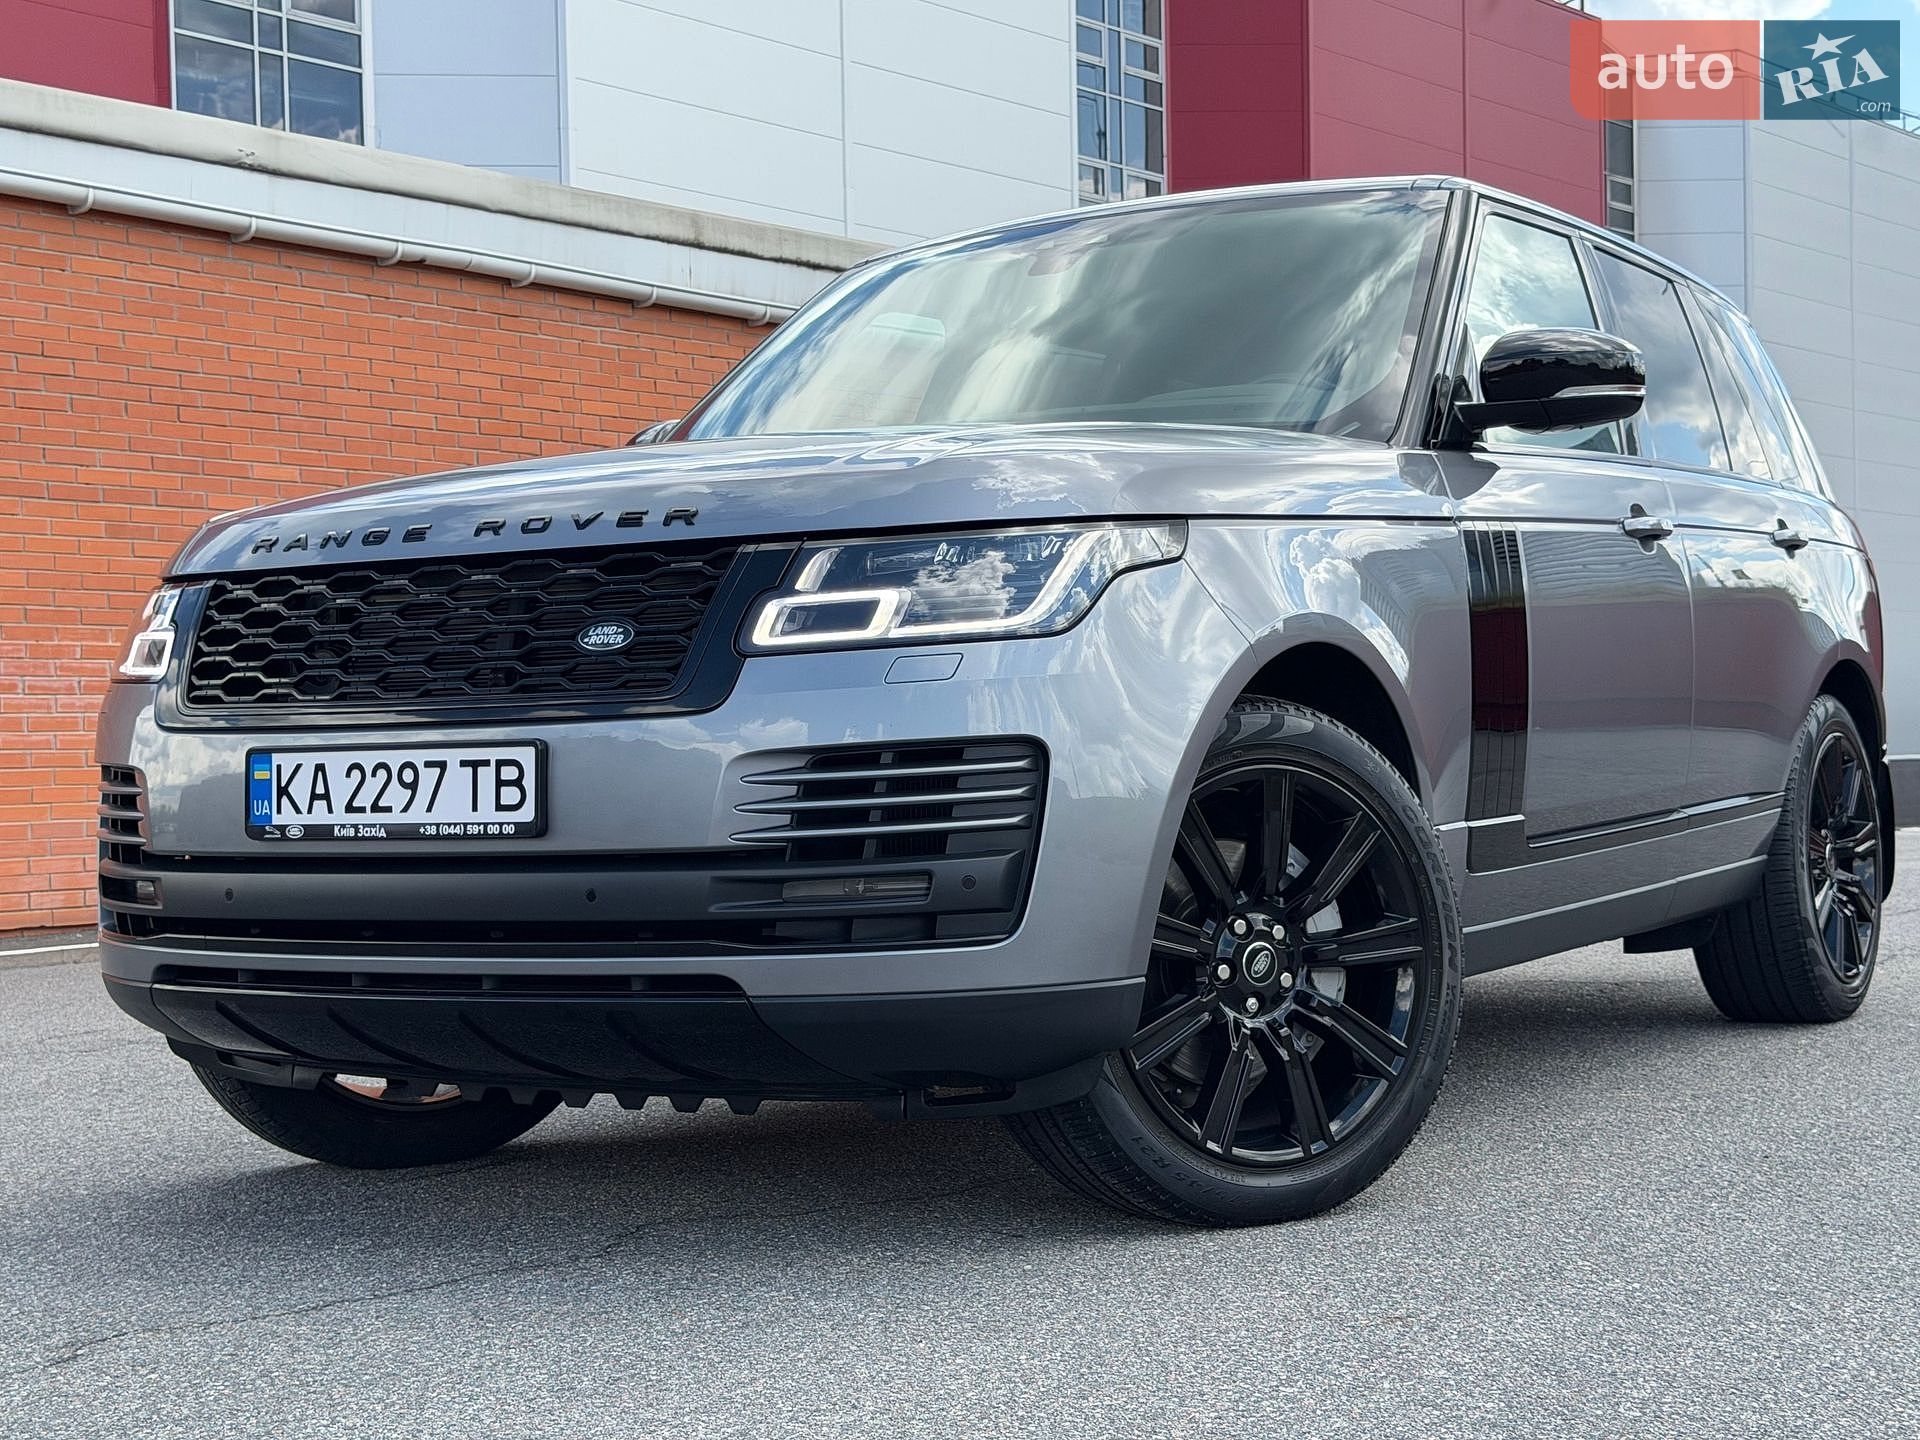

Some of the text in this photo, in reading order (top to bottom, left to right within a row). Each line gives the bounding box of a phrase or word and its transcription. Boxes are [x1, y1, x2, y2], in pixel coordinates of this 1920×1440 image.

[250, 506, 700, 555] RANGE ROVER
[588, 625, 618, 636] LAND
[588, 634, 625, 645] ROVER
[275, 758, 527, 815] KA 2297 TB
[254, 799, 271, 816] UA
[333, 824, 387, 838] Київ Захід
[419, 823, 515, 836] +38 (044) 591 00 00
